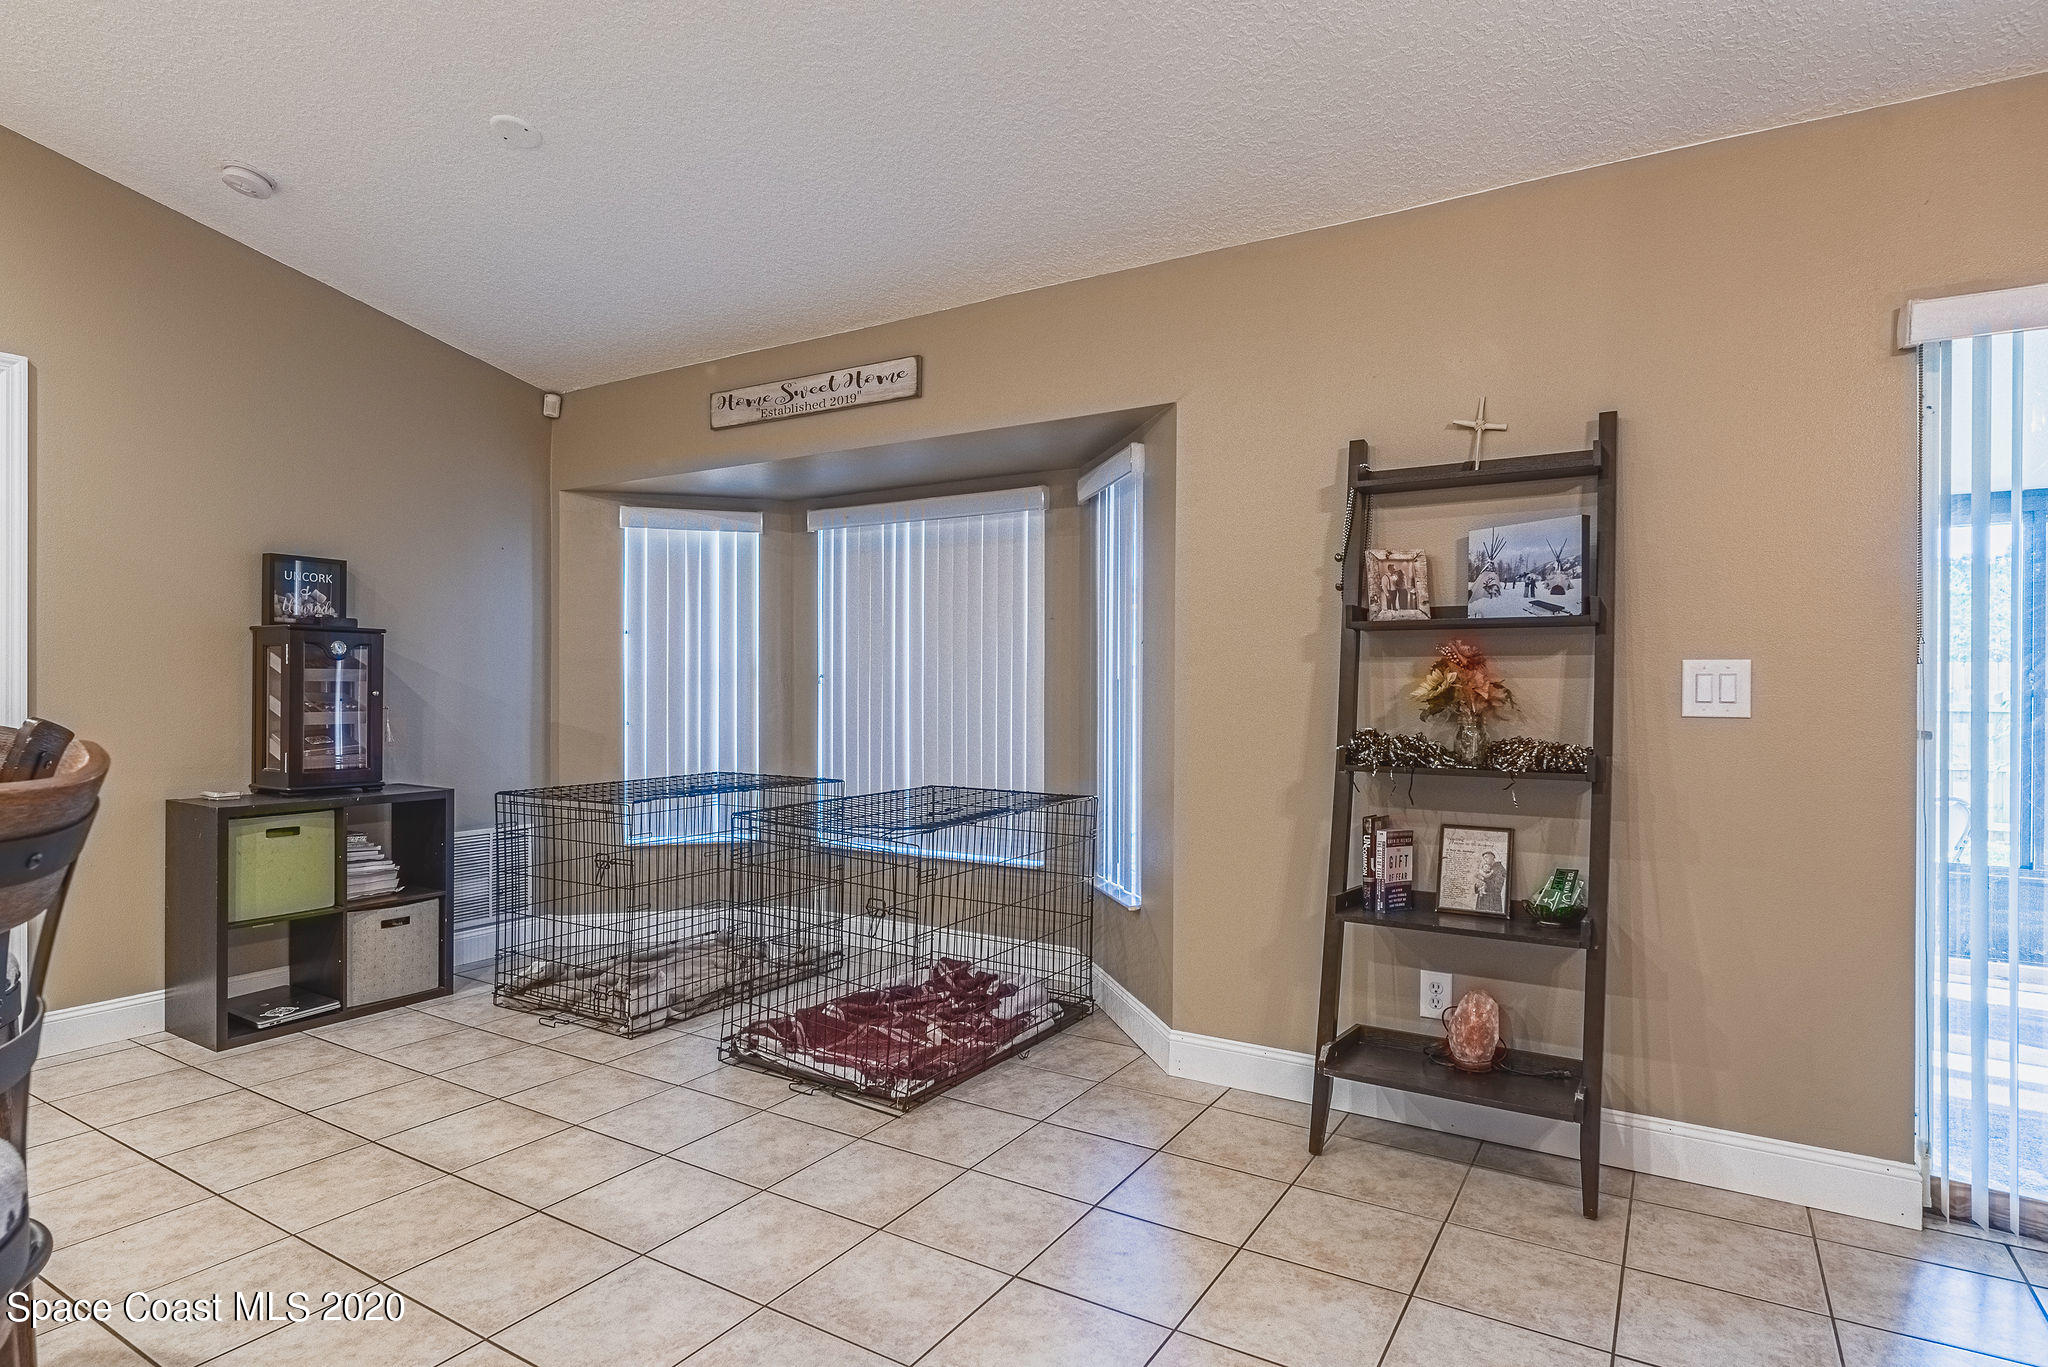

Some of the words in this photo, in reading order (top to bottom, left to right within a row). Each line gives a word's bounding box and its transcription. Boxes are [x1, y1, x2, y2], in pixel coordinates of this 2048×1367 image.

[717, 393, 773, 411] Home
[774, 375, 841, 405] Sweet
[843, 369, 909, 389] Home
[284, 570, 333, 584] UNCORK
[282, 597, 332, 615] Uwind
[1362, 834, 1371, 877] UNCOMMON
[1388, 854, 1409, 869] GIFT
[1389, 873, 1395, 881] OF
[1395, 872, 1408, 880] FEAR
